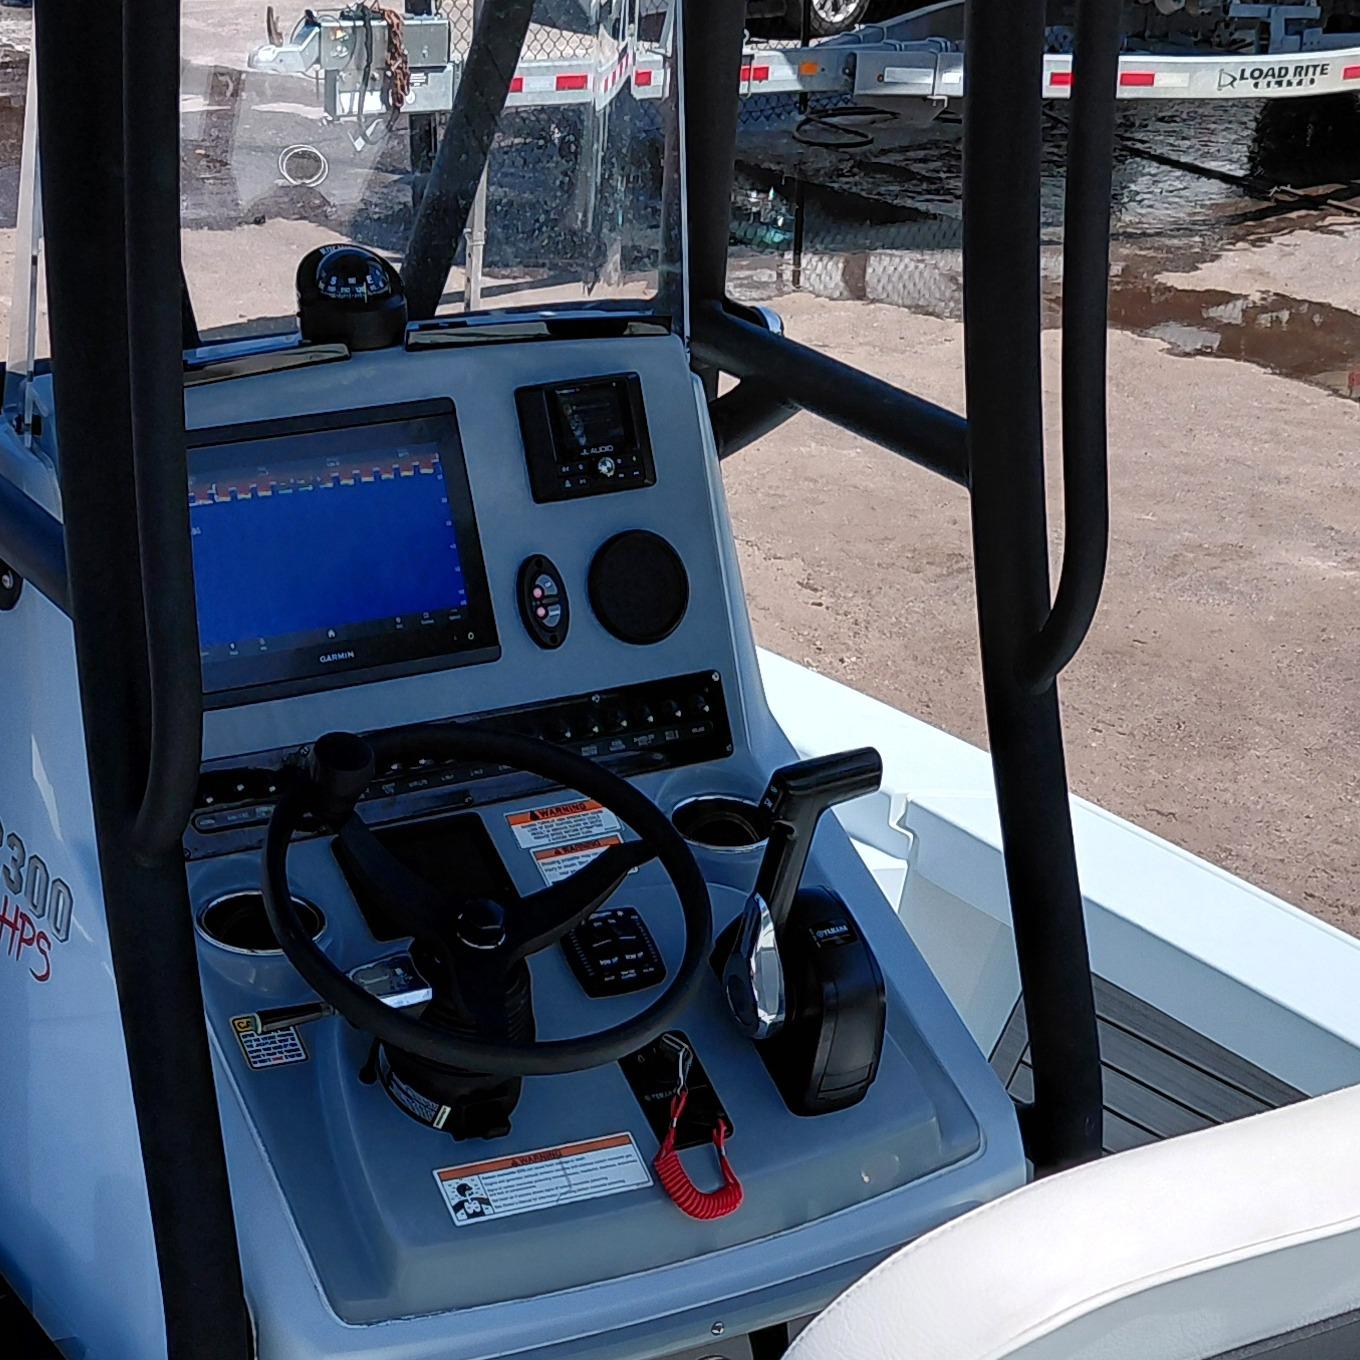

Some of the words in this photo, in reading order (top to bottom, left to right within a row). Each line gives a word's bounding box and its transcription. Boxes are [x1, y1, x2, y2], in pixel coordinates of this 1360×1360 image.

[1239, 66, 1289, 81] LOAD
[1293, 63, 1330, 78] RITE
[590, 445, 614, 455] AUDIO
[319, 651, 355, 664] GARMIN
[541, 803, 587, 818] WARNING
